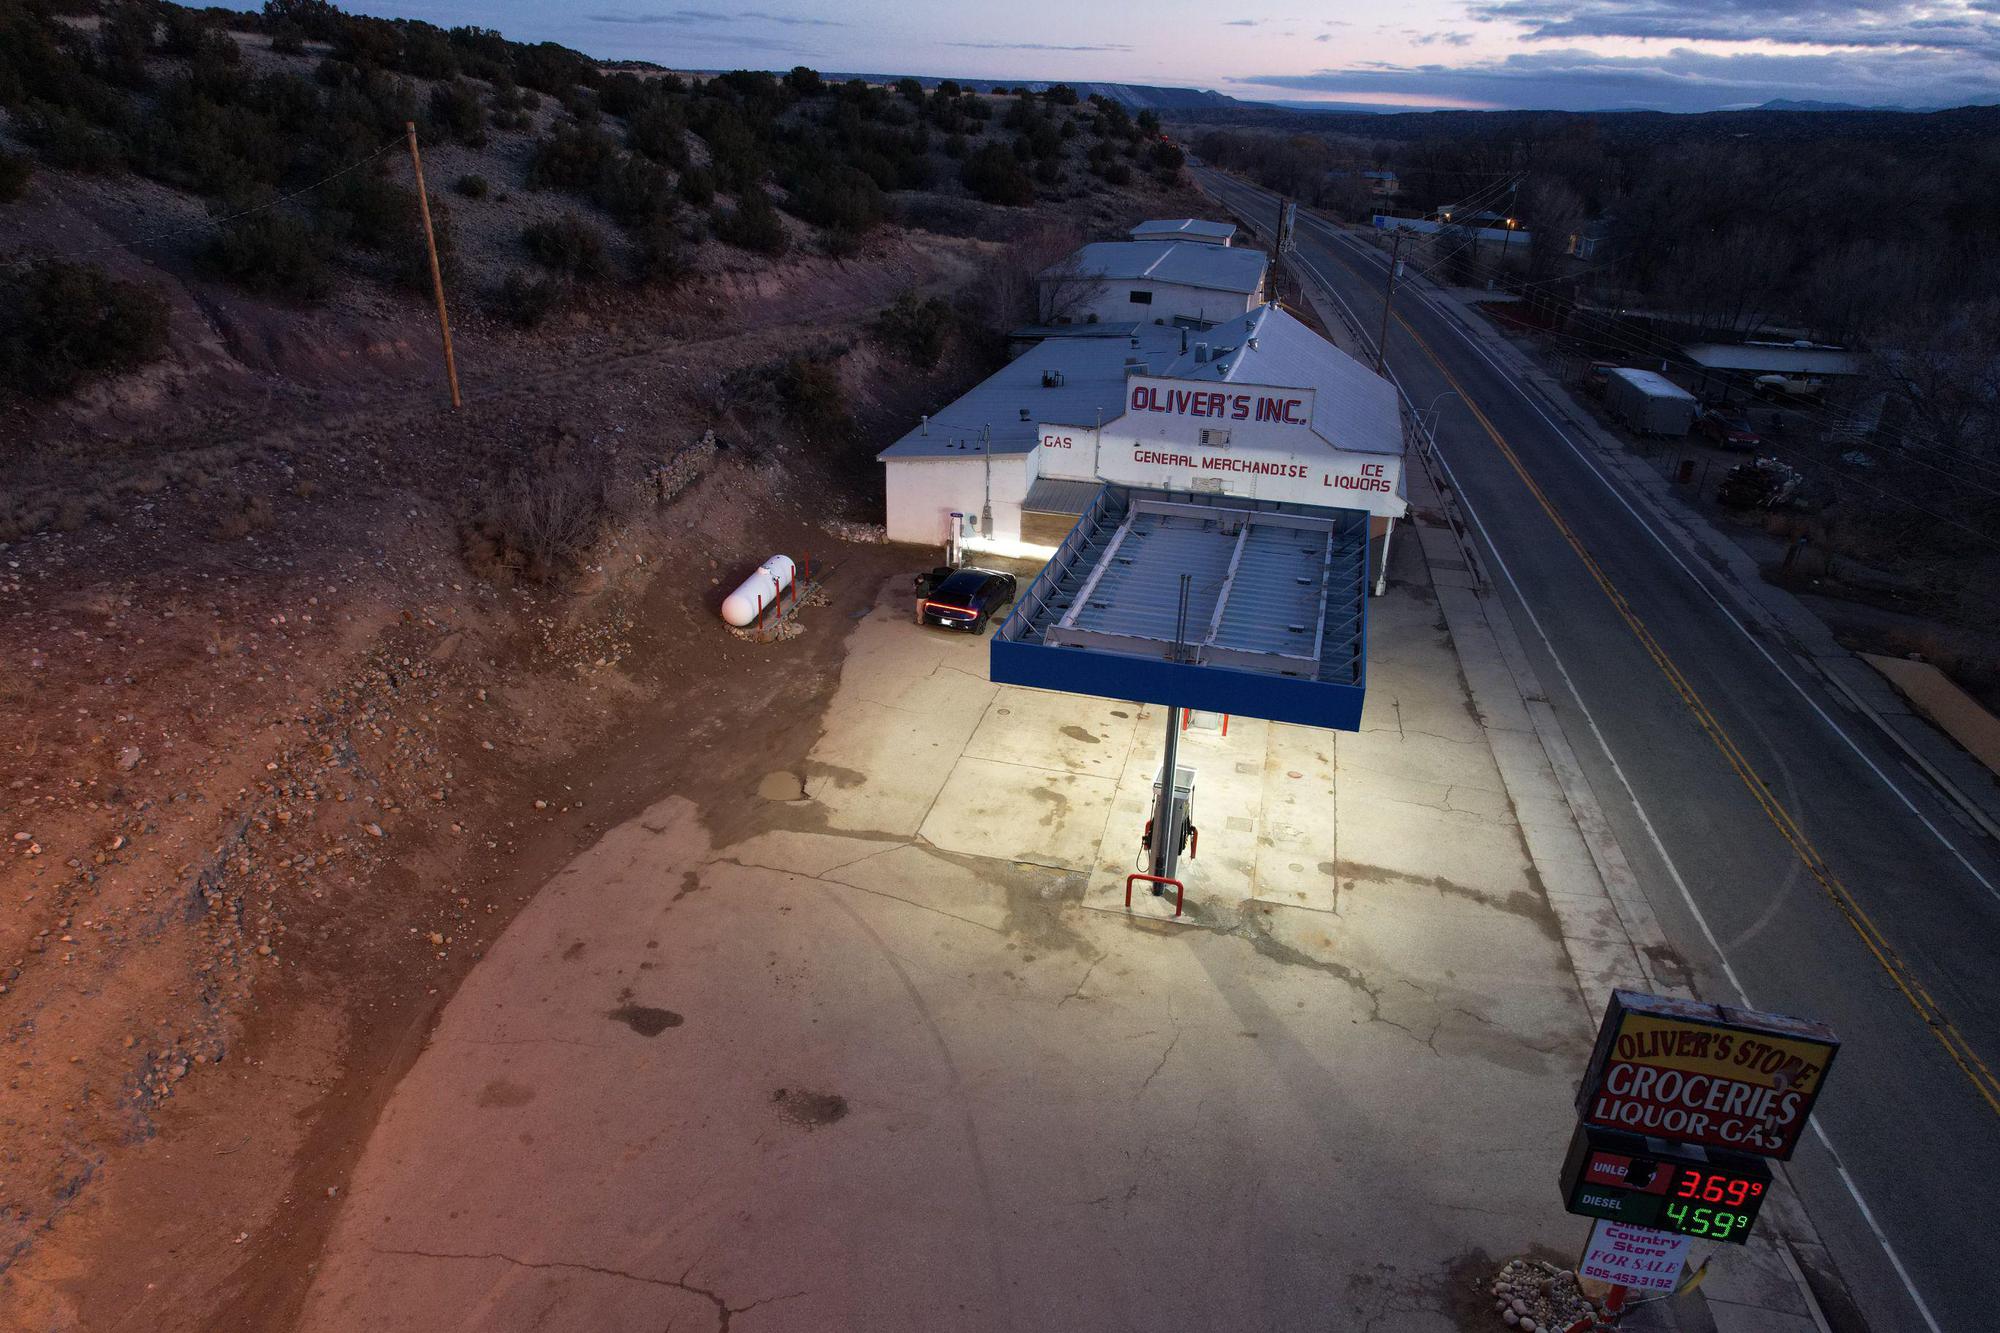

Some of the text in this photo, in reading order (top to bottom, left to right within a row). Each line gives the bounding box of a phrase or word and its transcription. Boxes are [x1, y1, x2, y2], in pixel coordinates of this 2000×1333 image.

[1132, 386, 1307, 425] OLIVER'S INC.
[1044, 435, 1072, 449] GAS
[1134, 450, 1308, 478] GENERAL MERCHANDISE
[1361, 463, 1384, 477] ICE
[1324, 474, 1391, 492] LIQUORS
[1617, 1030, 1820, 1089] OLIVER'S STORE
[1606, 1063, 1802, 1125] GROCERIES
[1582, 1194, 1622, 1210] DIESEL
[1605, 1228, 1682, 1249] Country
[1613, 1241, 1666, 1257] Store
[1589, 1250, 1679, 1274] FOR SALE
